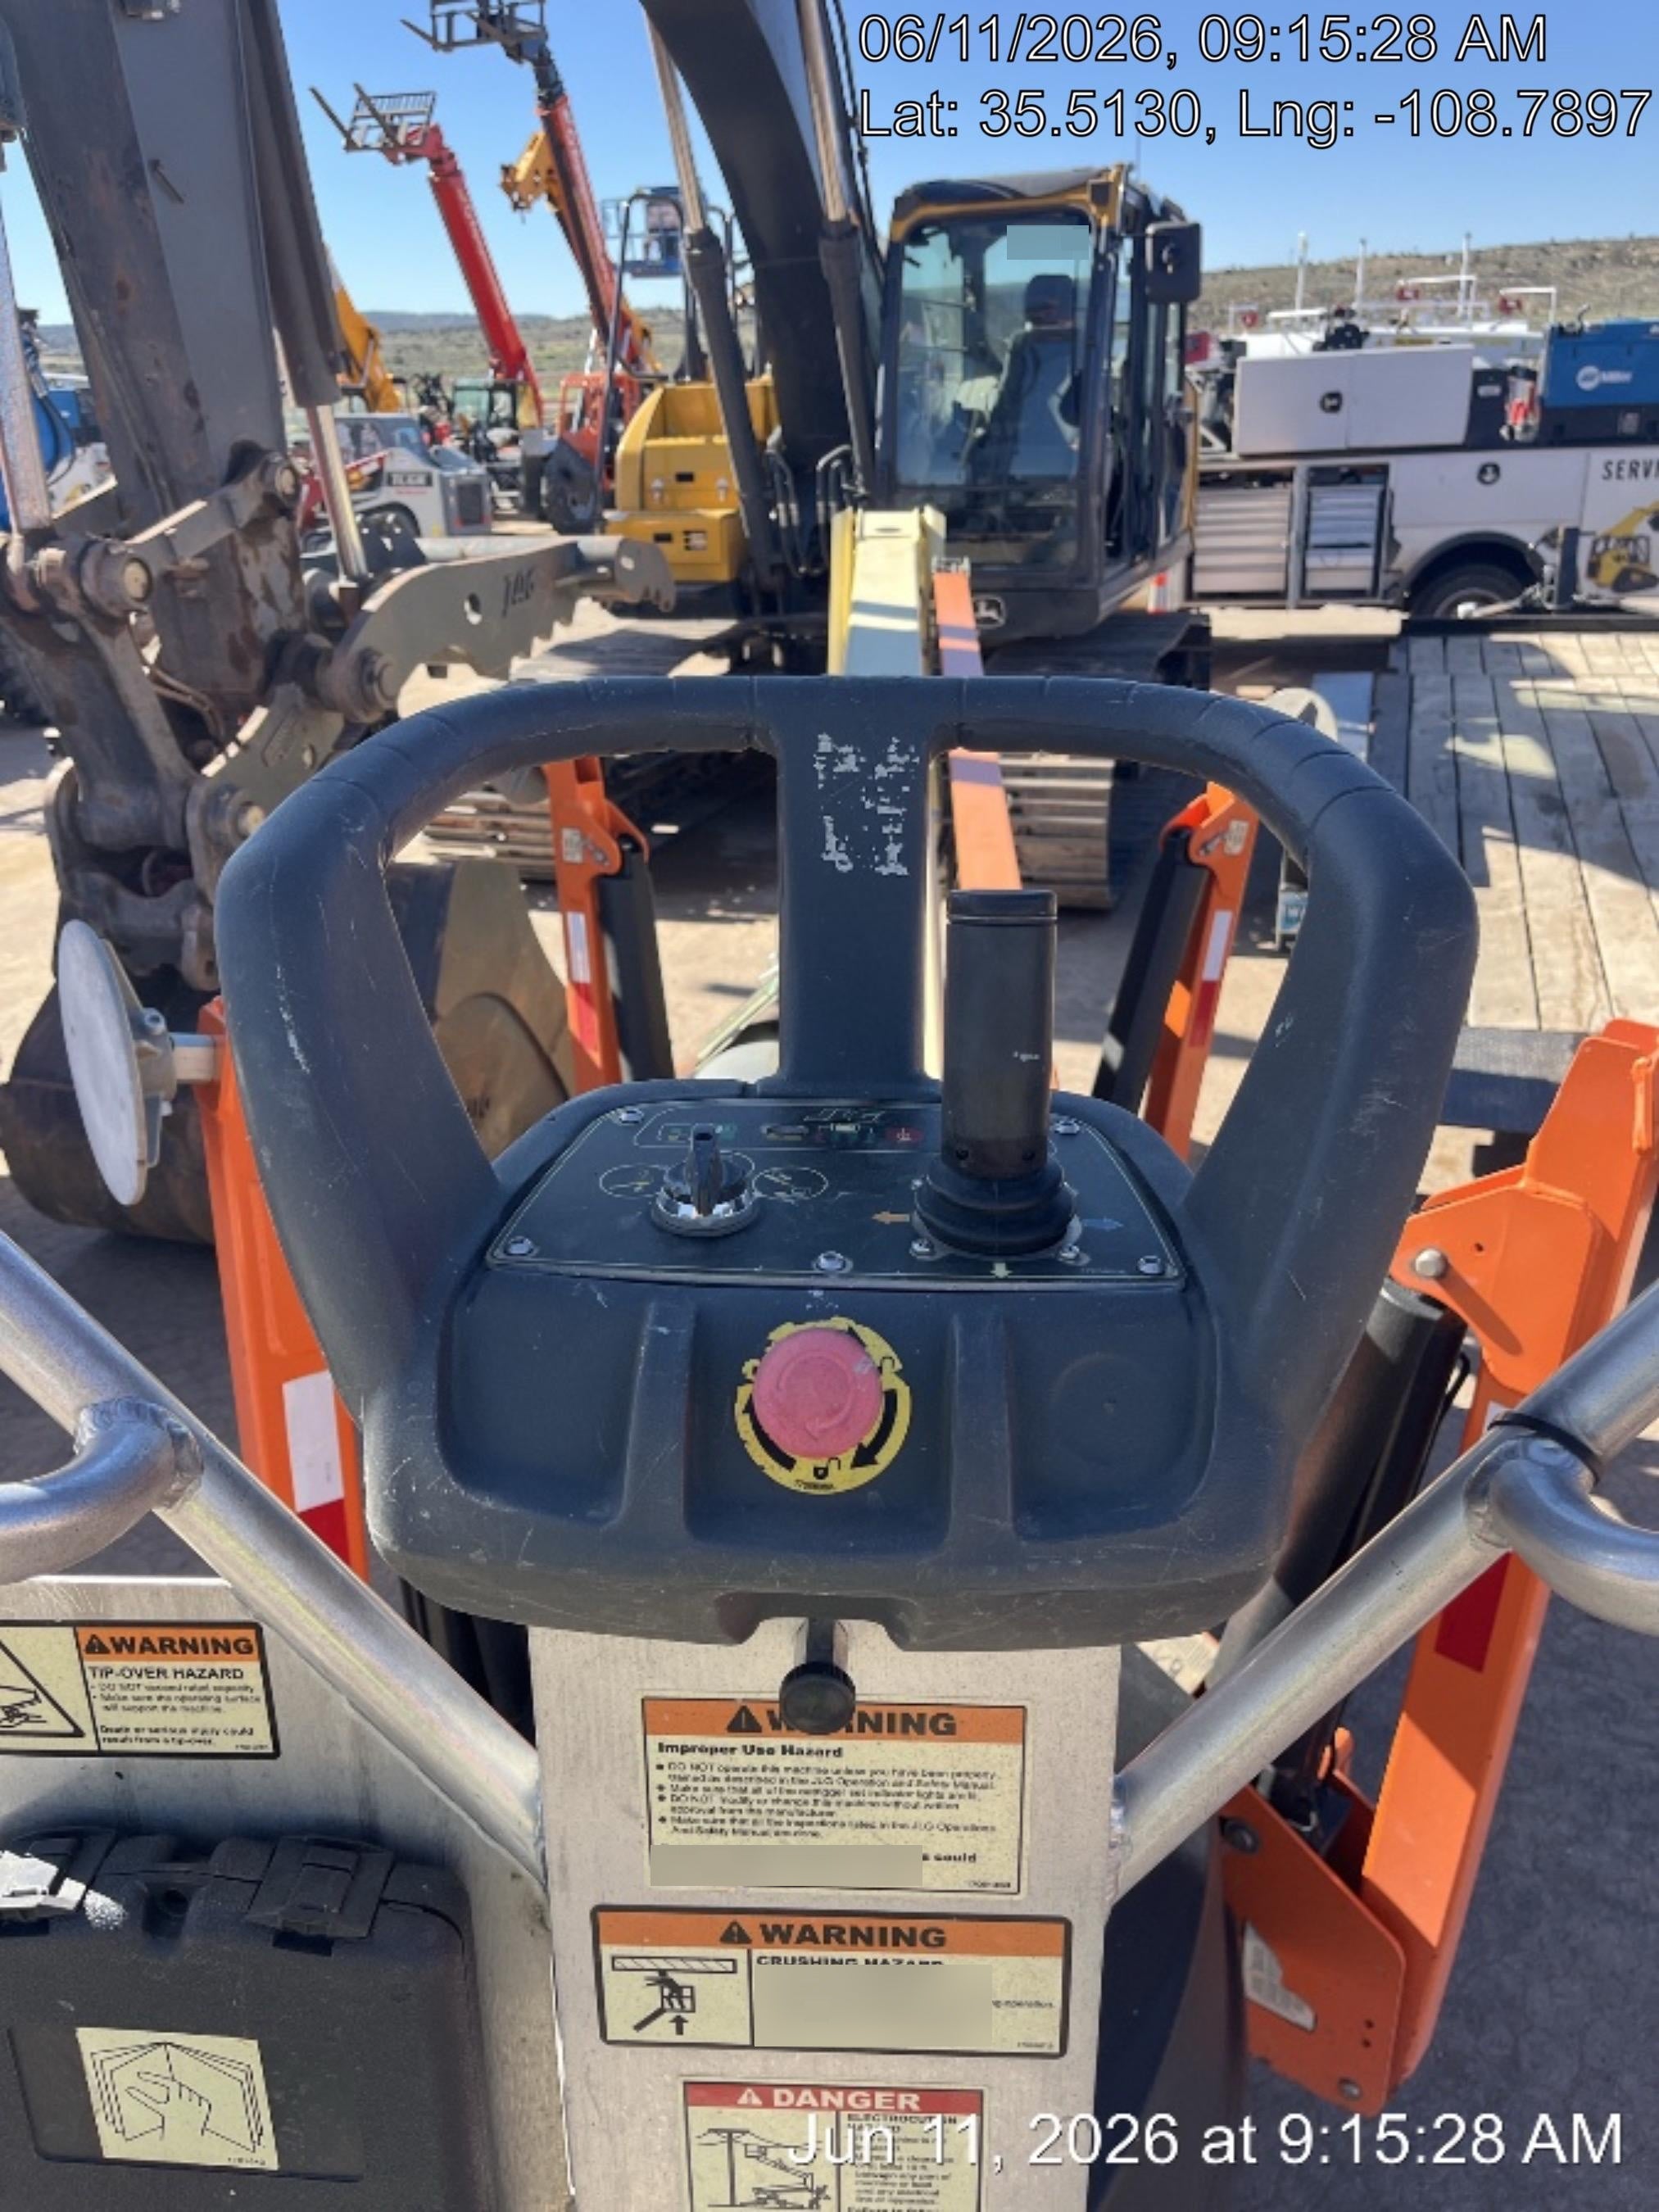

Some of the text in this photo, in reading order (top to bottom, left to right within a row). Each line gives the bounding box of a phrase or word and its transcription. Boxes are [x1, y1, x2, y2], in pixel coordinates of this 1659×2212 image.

[109, 1636, 255, 1656] WARNING
[88, 1666, 244, 1679] TIP-OVER HAZARD
[657, 1742, 844, 1758] Improper Use Hazard
[759, 1923, 947, 1948] WARNING
[773, 2088, 922, 2111] DANGER
